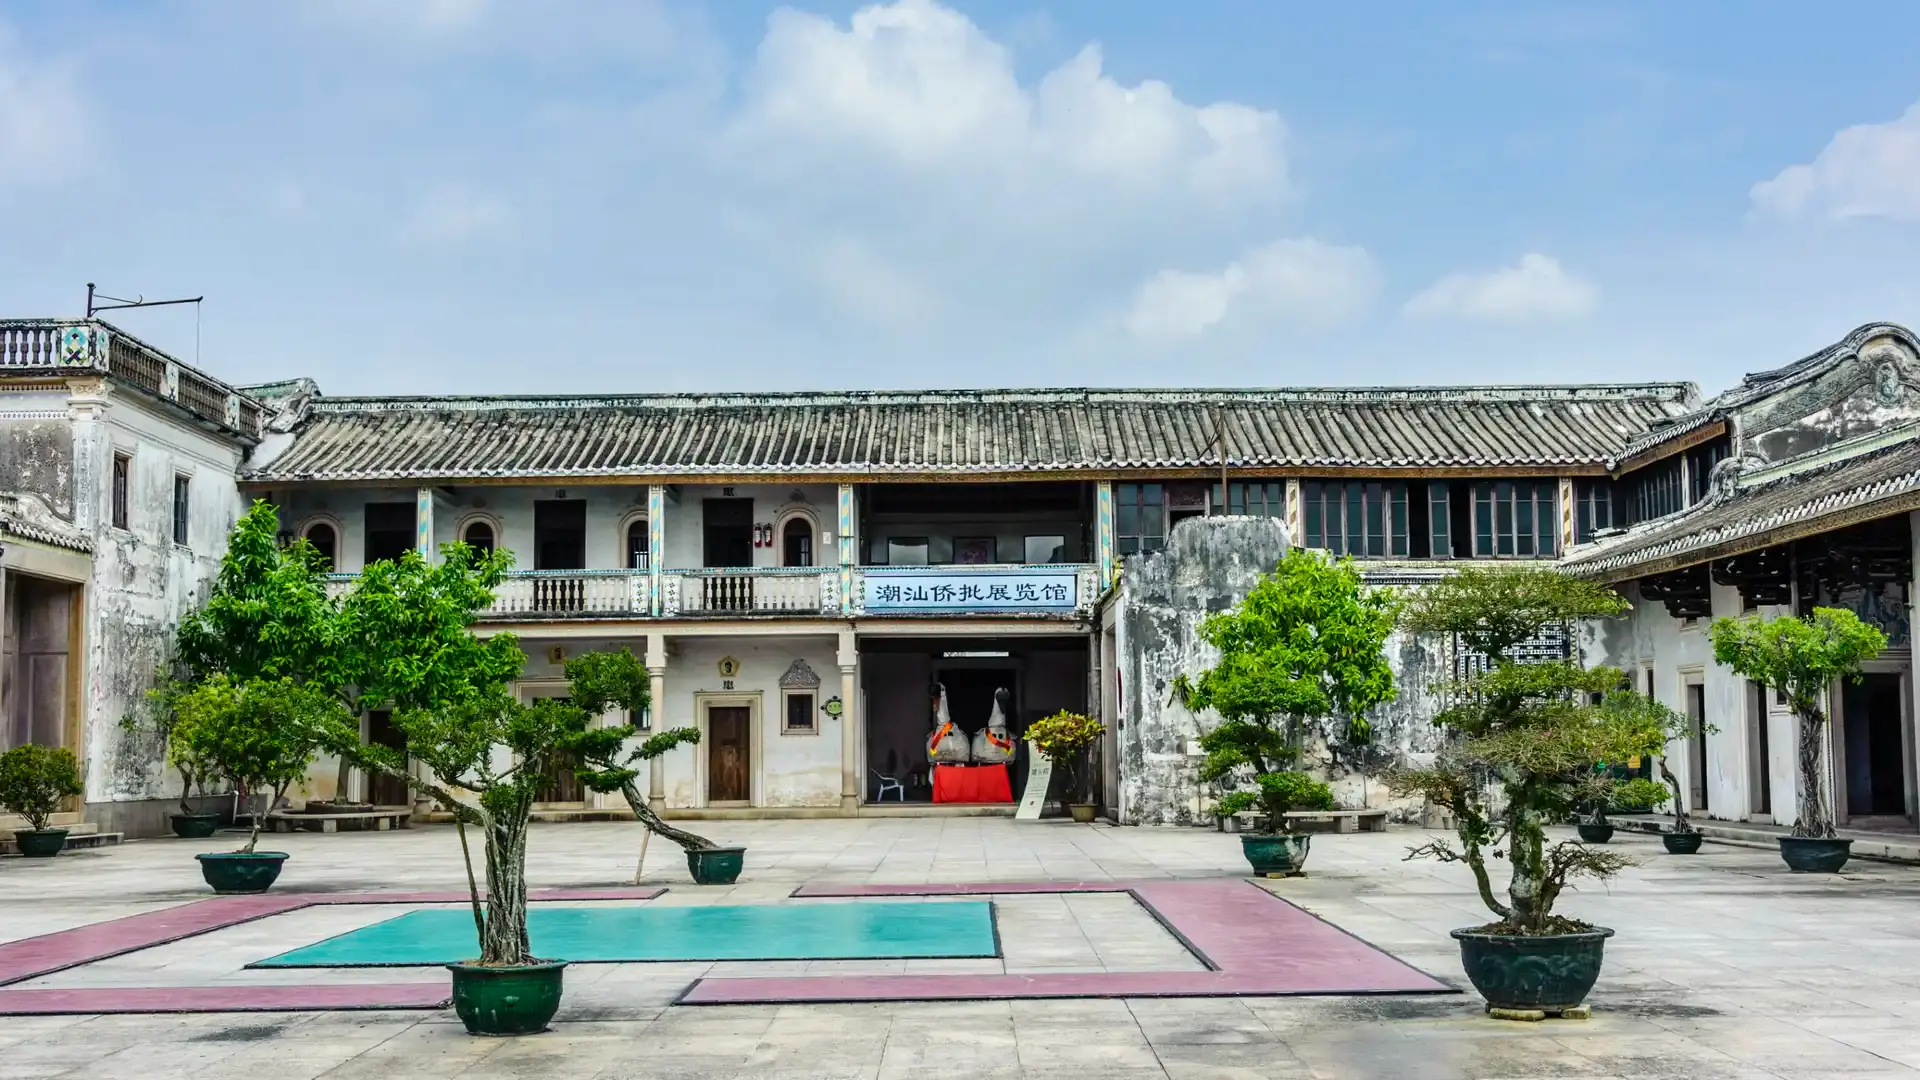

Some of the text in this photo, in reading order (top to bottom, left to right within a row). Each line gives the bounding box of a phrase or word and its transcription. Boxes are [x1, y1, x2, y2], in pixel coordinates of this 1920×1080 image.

[876, 584, 1067, 602] 潮汕侨批展览馆
